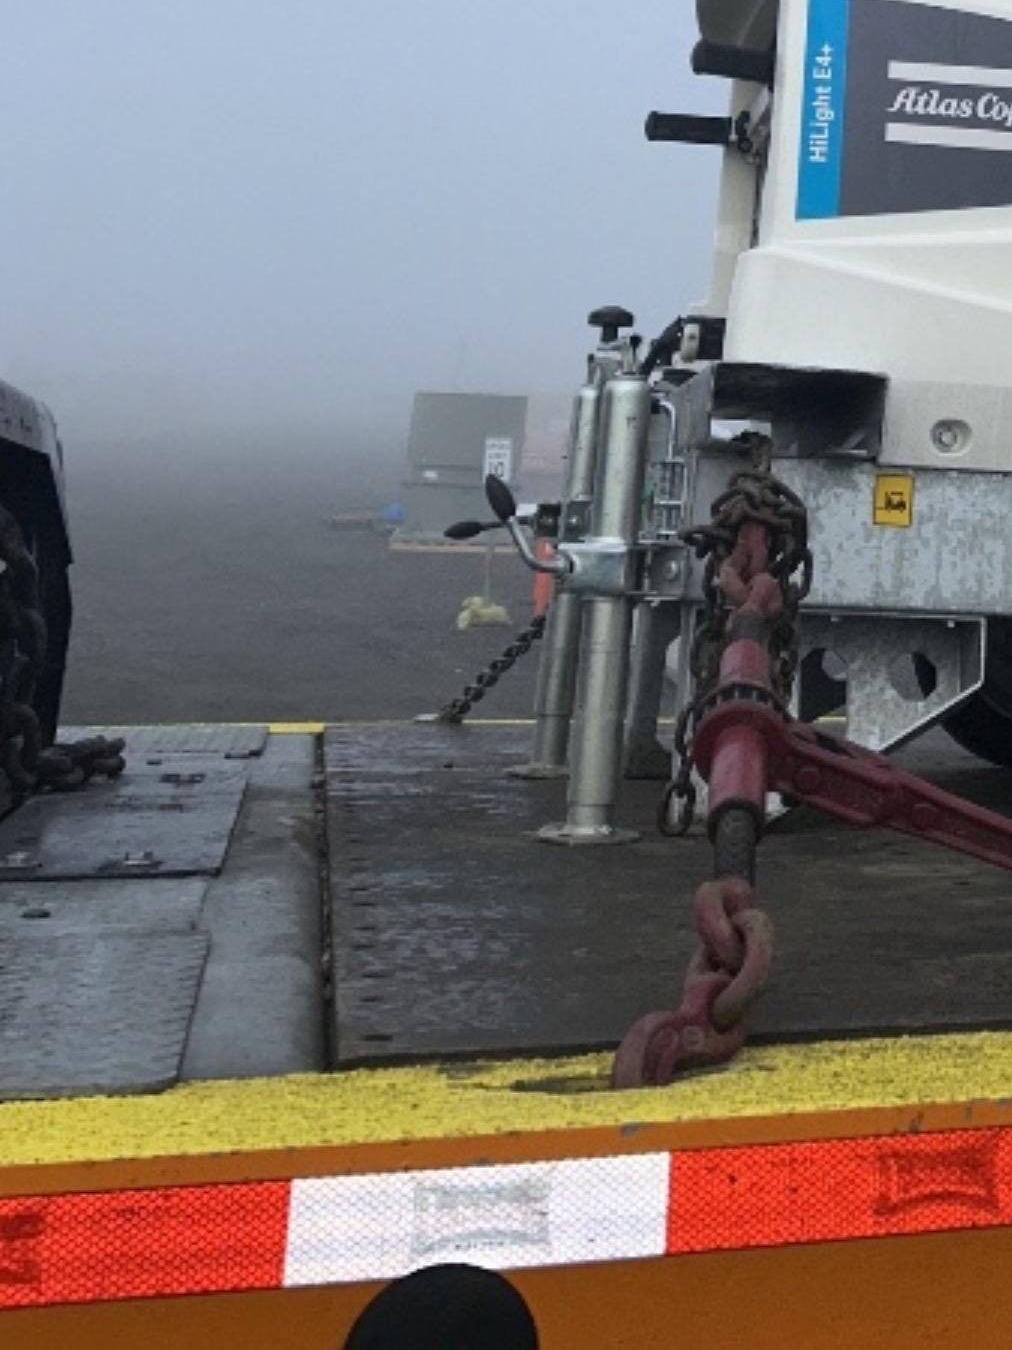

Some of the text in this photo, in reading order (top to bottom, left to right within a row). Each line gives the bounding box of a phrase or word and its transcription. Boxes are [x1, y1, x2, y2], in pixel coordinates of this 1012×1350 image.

[808, 42, 835, 164] HiLight E4+
[886, 86, 974, 119] Atlas
